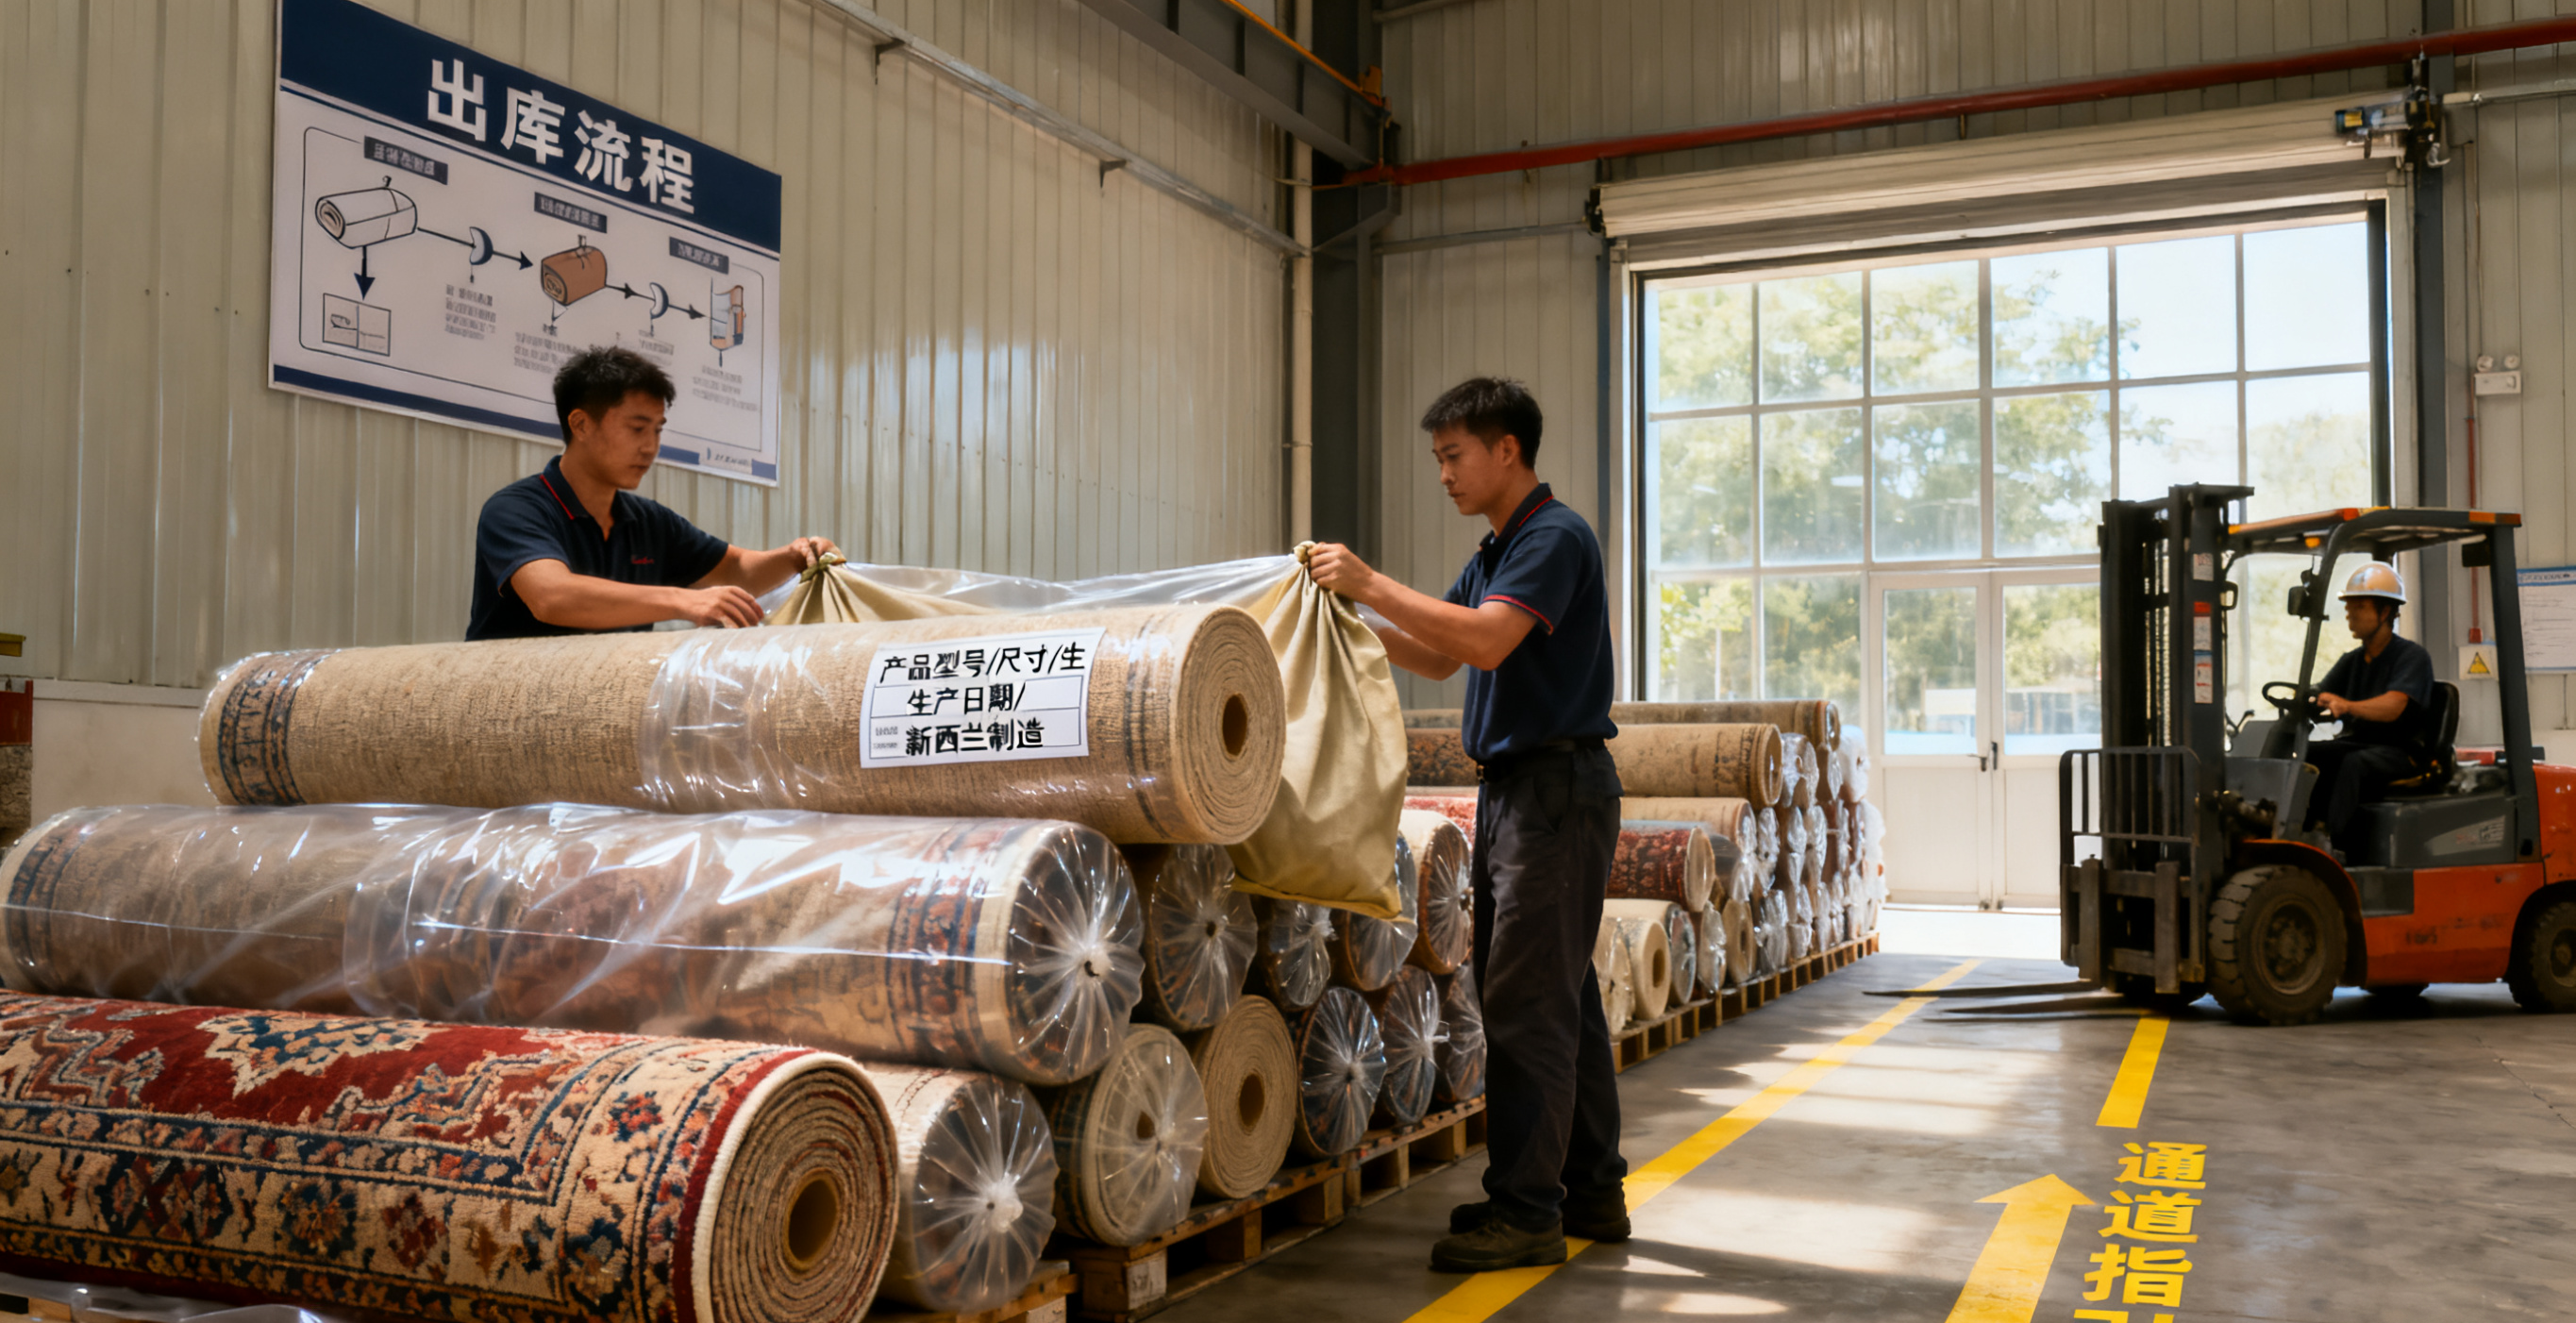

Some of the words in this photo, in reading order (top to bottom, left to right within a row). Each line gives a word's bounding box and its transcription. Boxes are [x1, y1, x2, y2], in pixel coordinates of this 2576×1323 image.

[427, 58, 694, 214] 出库流程
[905, 716, 1045, 756] 新西兰制造
[2074, 1141, 2208, 1323] 通道指
